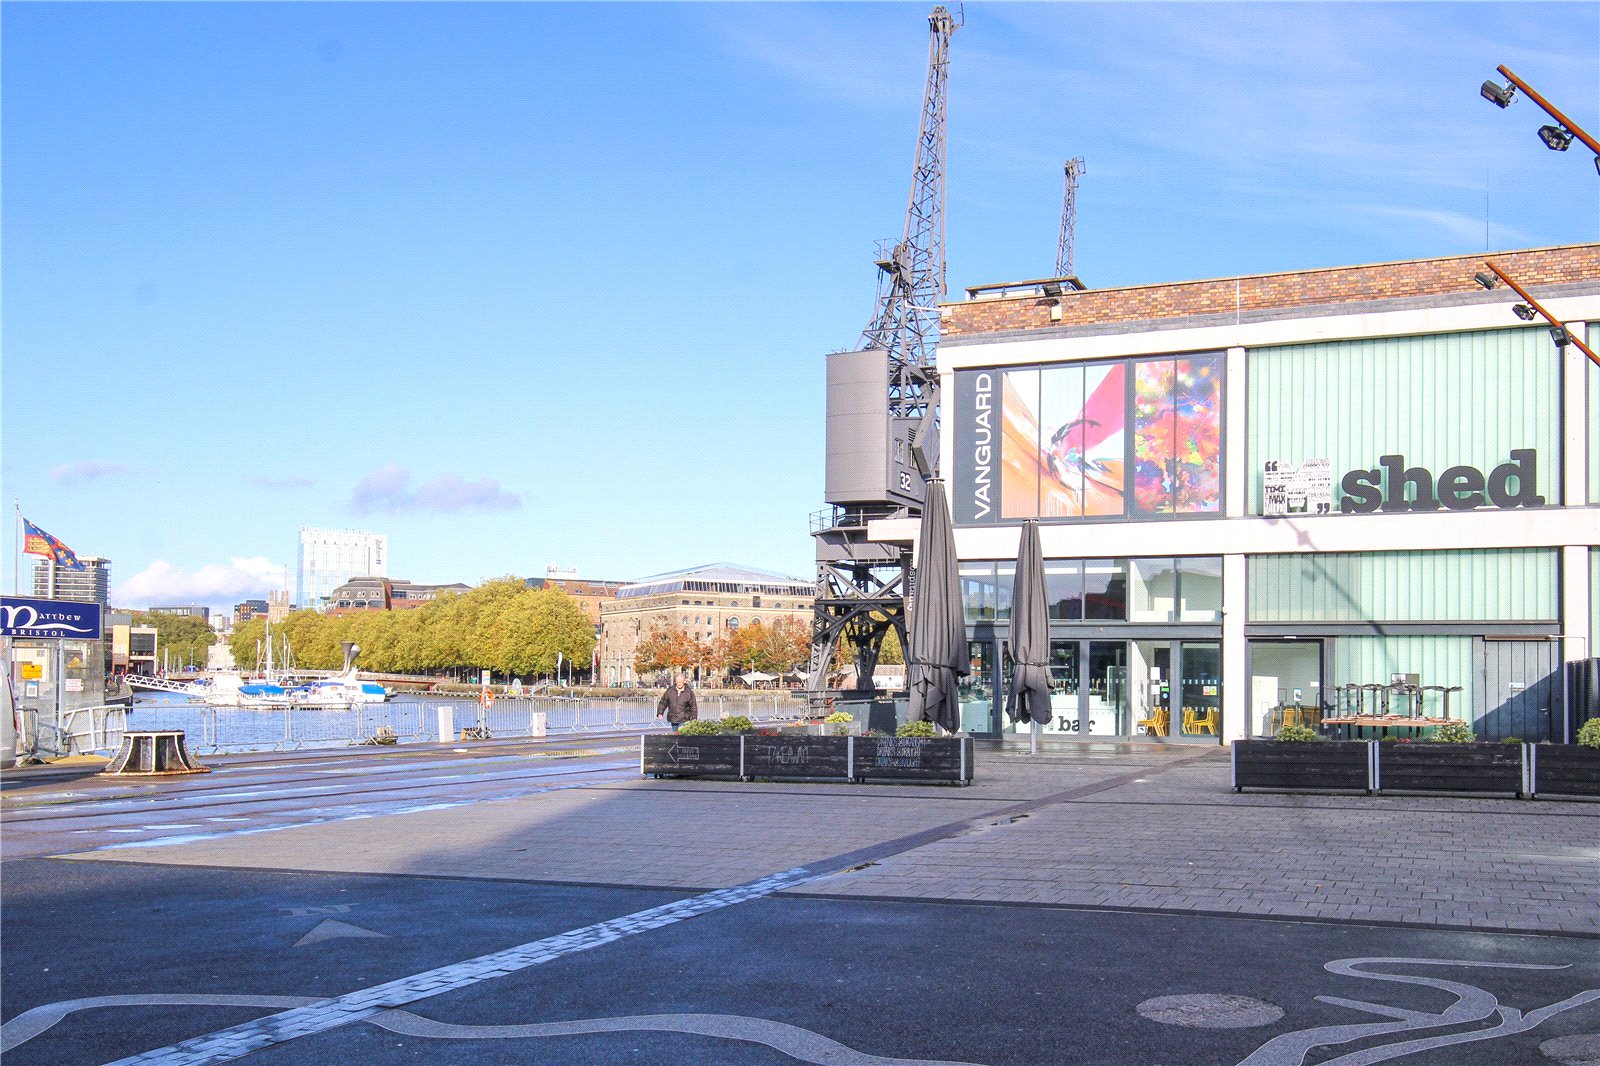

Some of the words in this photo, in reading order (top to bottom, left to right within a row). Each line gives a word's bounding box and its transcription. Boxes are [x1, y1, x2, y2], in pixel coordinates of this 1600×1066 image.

[974, 373, 992, 520] VANGUARD
[900, 472, 911, 491] 32
[1341, 448, 1546, 514] shed
[12, 629, 65, 637] BRISTOL
